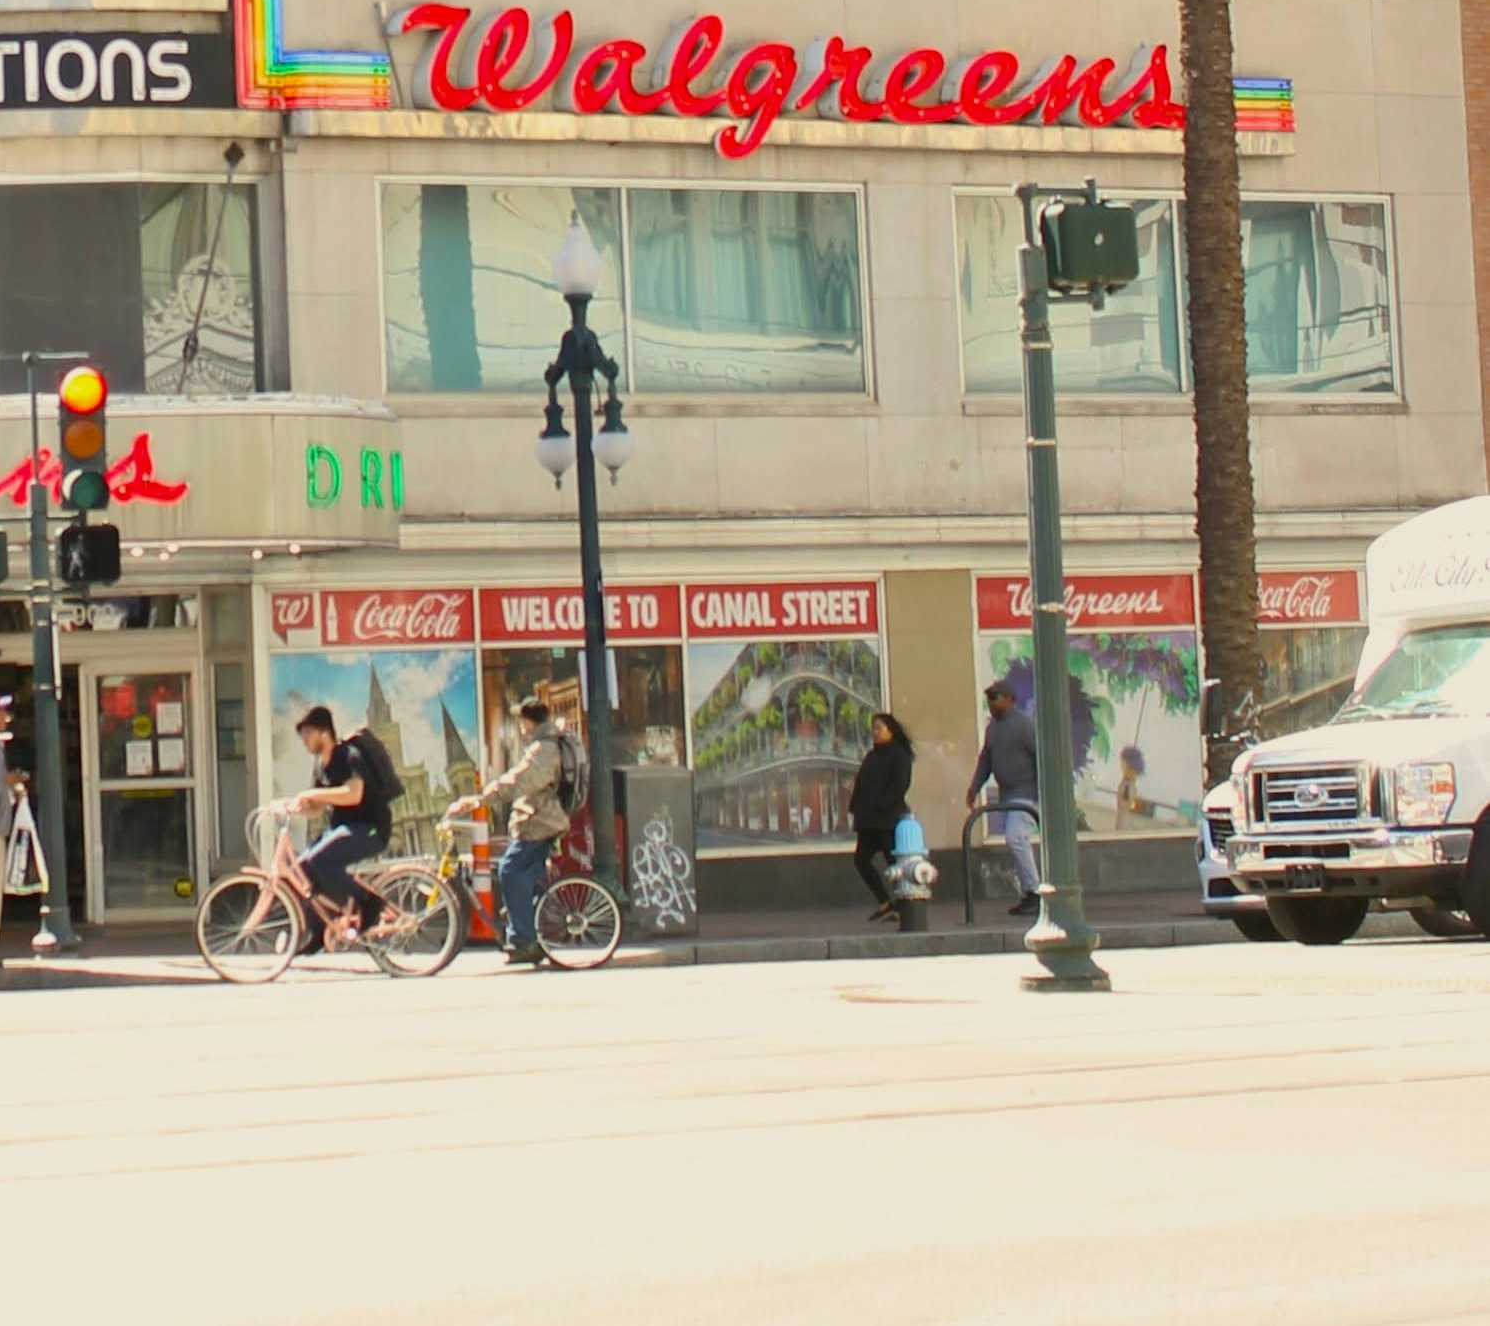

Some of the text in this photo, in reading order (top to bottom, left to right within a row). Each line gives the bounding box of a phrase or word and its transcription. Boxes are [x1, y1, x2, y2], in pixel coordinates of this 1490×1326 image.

[395, 2, 1187, 158] Walgreens
[275, 596, 309, 625] W
[354, 593, 467, 640] Coca-Cola
[501, 595, 659, 632] WELCOE TO
[691, 589, 870, 629] CANAL STREET
[1006, 583, 1165, 627] Wlgreens
